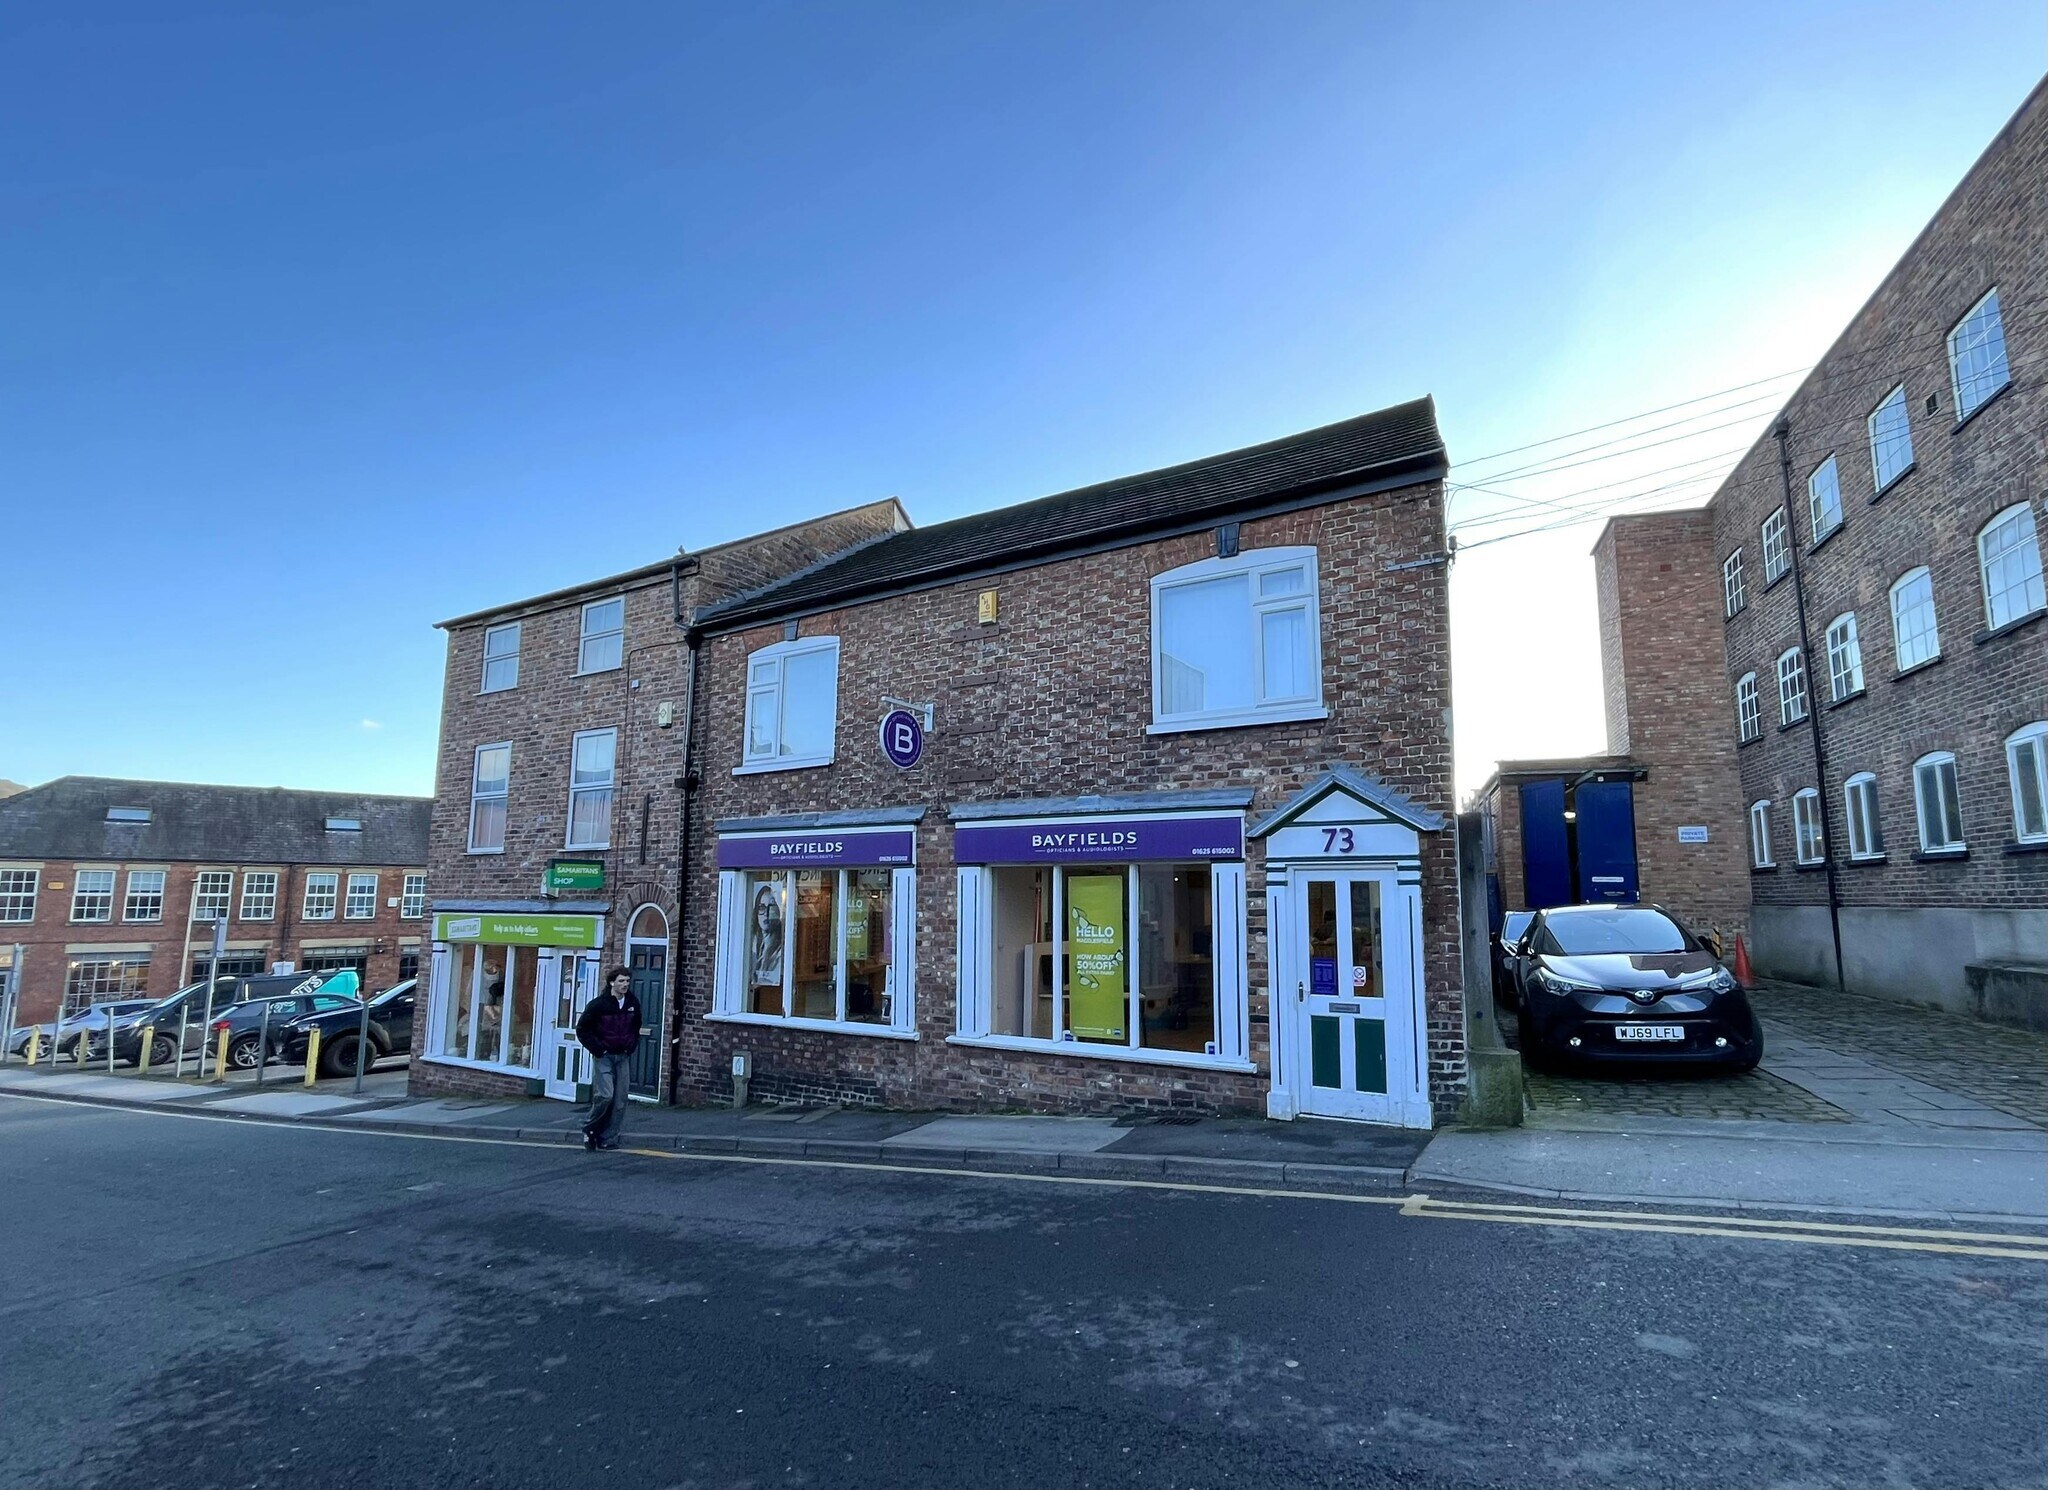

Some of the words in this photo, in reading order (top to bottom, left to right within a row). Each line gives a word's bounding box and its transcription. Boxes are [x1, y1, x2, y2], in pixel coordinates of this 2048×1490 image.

[895, 722, 913, 754] B
[1032, 831, 1138, 847] BAYFIELDS
[1321, 827, 1354, 853] 73
[770, 842, 843, 854] BAYFIELDS
[557, 866, 599, 875] SAMARITANS
[553, 877, 574, 885] SHOP
[1076, 926, 1114, 938] HELLO
[1620, 1027, 1652, 1038] WJ69
[1655, 1027, 1680, 1038] LFL
